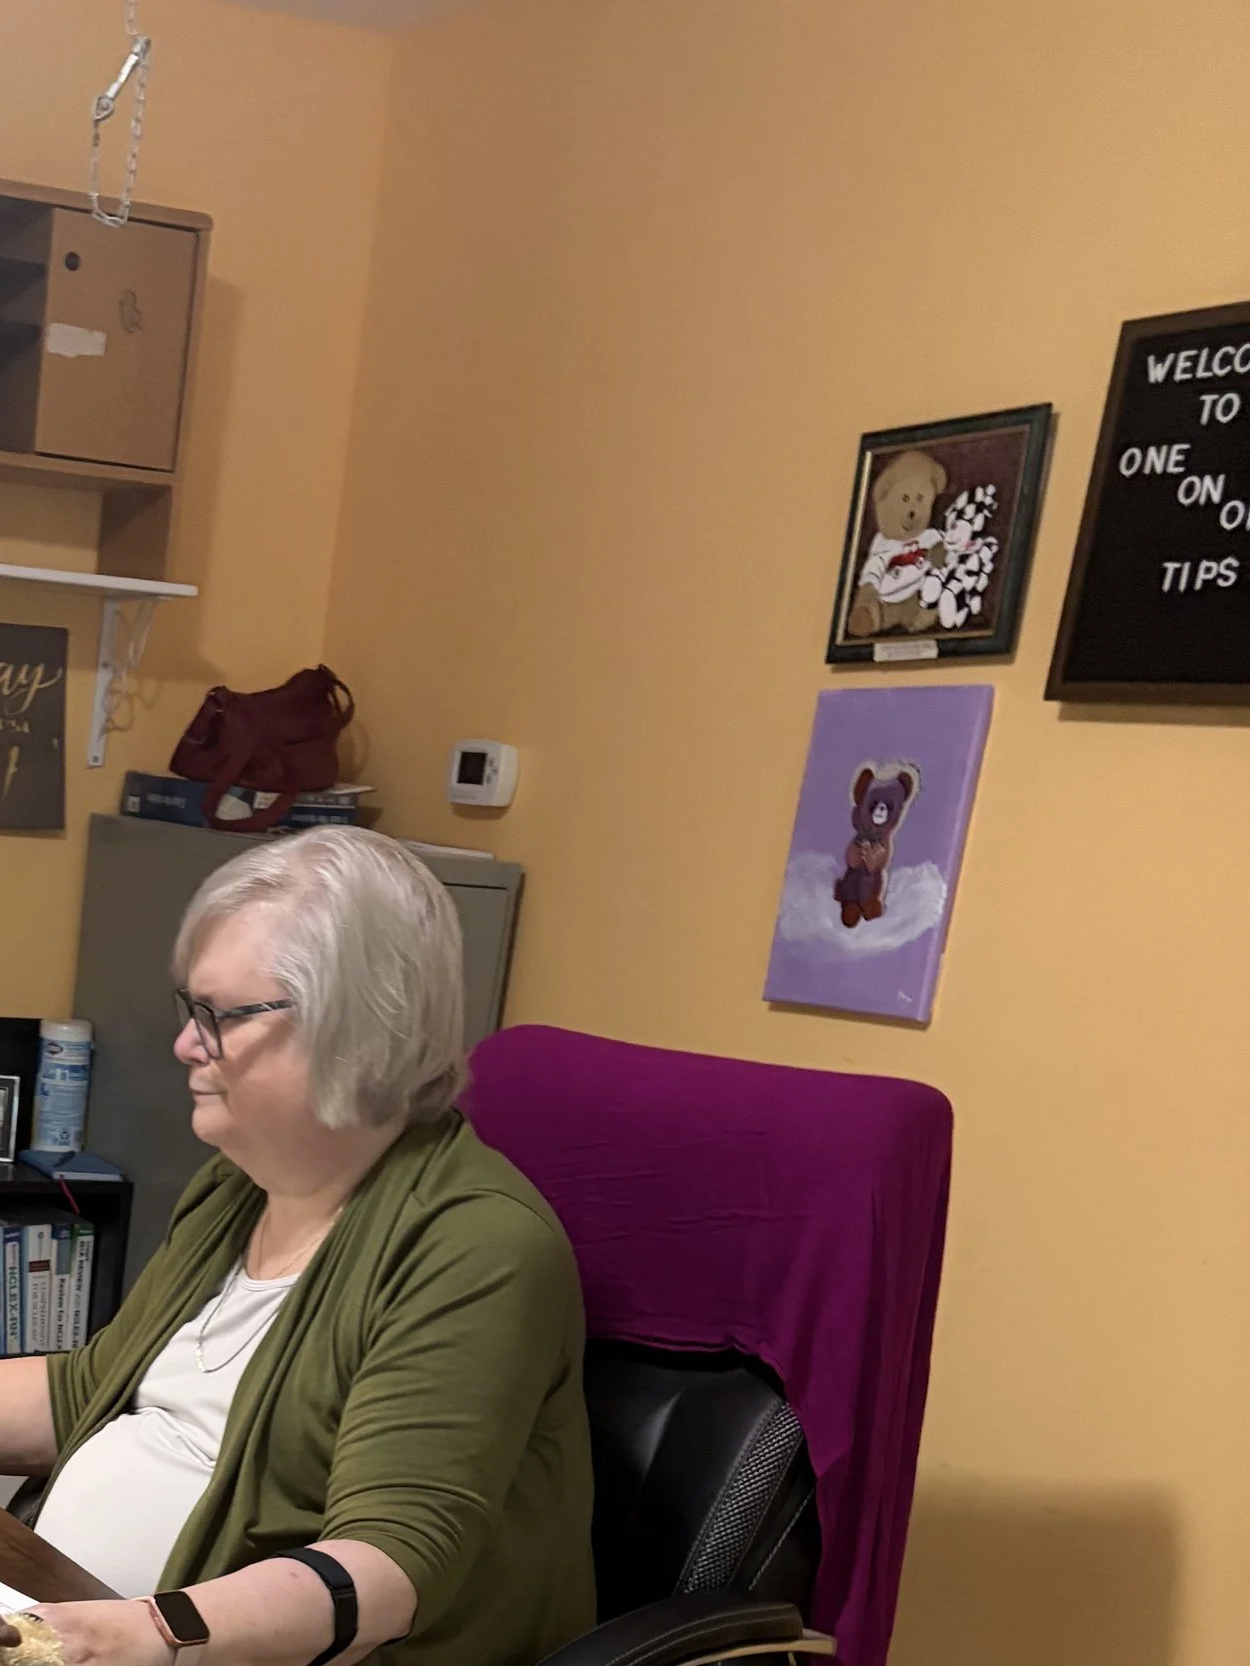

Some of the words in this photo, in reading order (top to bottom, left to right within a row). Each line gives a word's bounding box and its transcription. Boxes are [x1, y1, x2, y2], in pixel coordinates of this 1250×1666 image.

[1199, 392, 1241, 425] TO
[1119, 443, 1190, 478] ONE
[1177, 473, 1226, 507] ON
[1161, 557, 1240, 593] TIPS
[76, 1259, 84, 1292] REVIEW
[58, 1278, 66, 1308] Review
